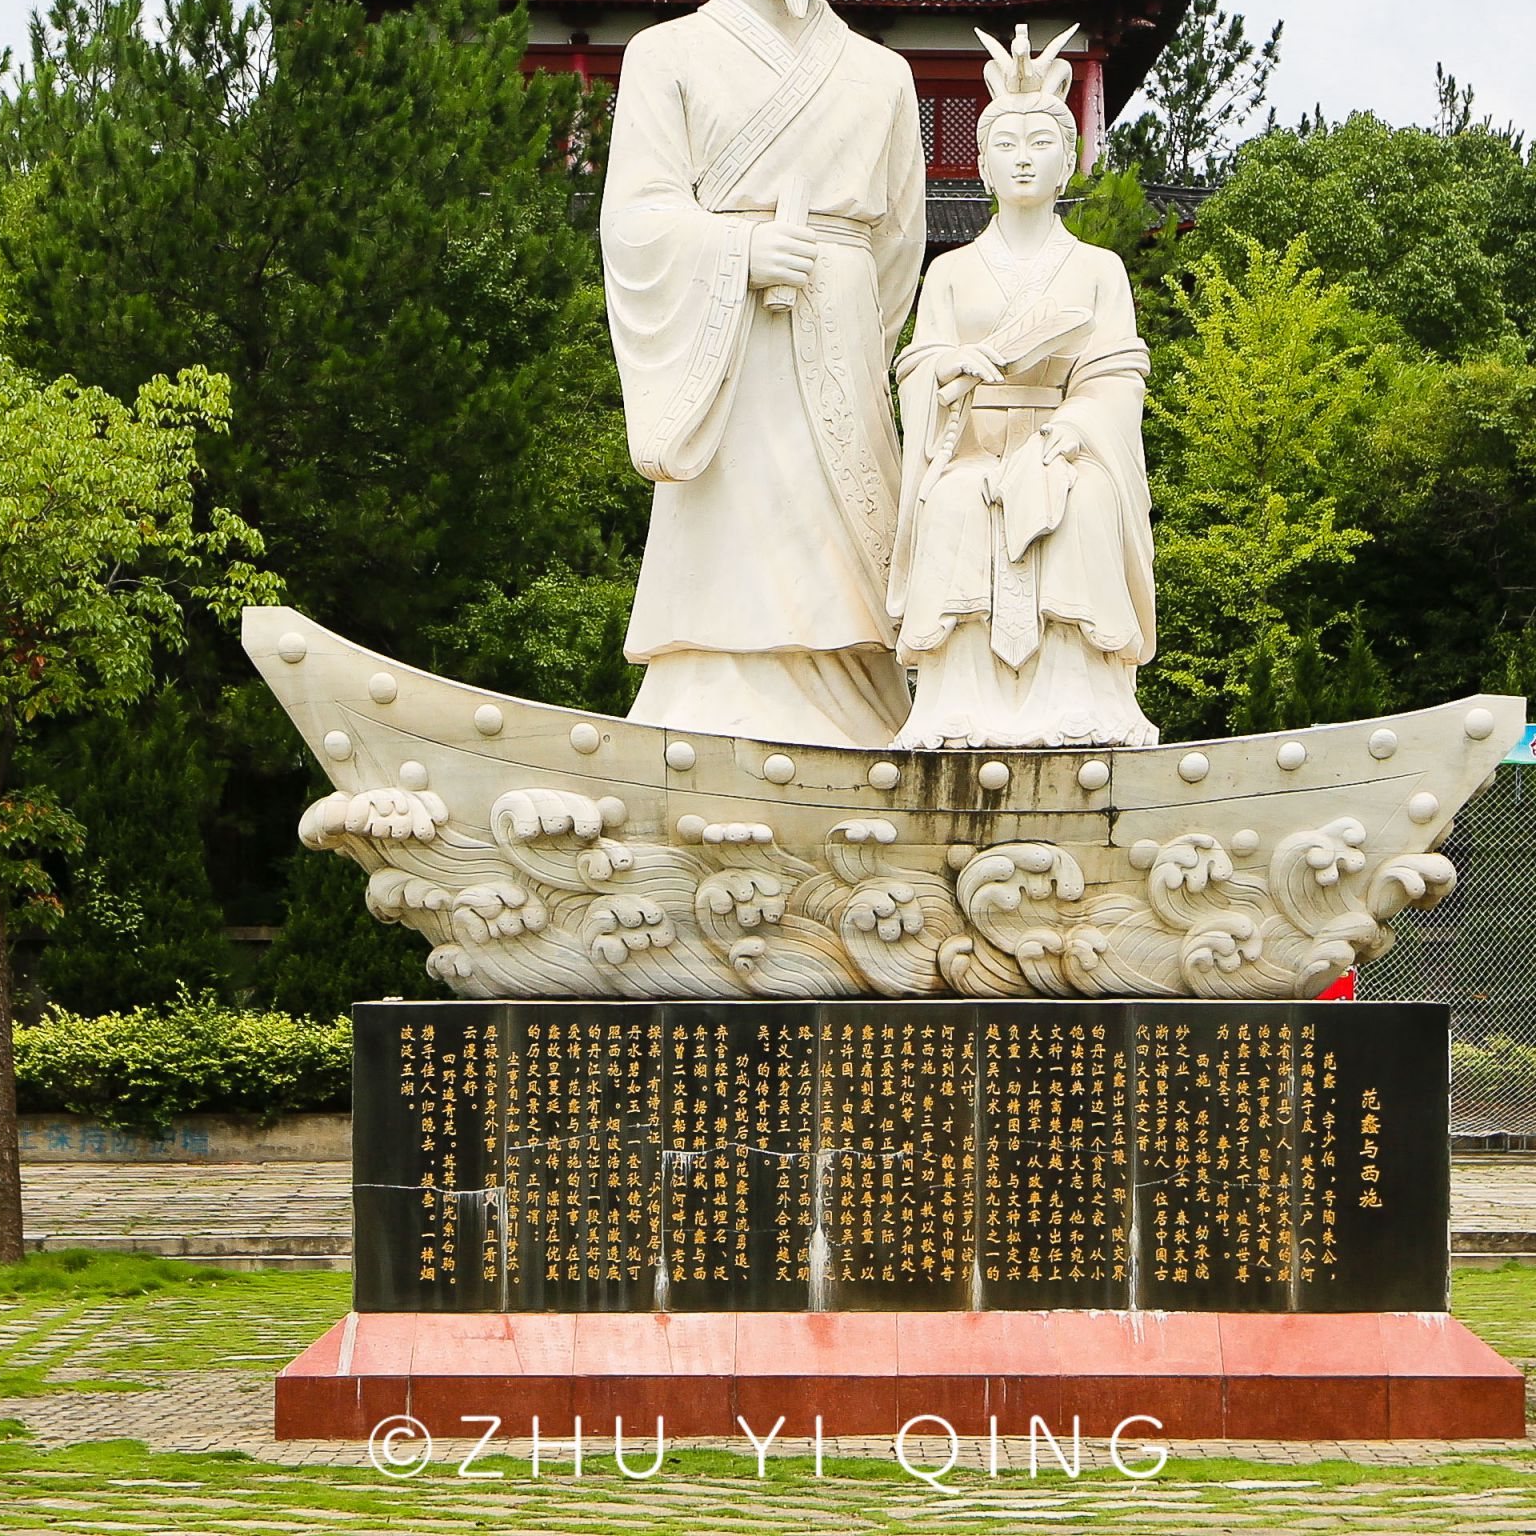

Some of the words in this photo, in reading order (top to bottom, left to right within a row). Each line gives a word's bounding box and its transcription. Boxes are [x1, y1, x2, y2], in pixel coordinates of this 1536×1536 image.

[400, 1024, 413, 1111] 波泛五湖。
[463, 1024, 477, 1111] 云漫卷舒。
[1135, 1024, 1151, 1166] 代四大美女之首。
[1360, 1088, 1380, 1208] 范蠡与西施
